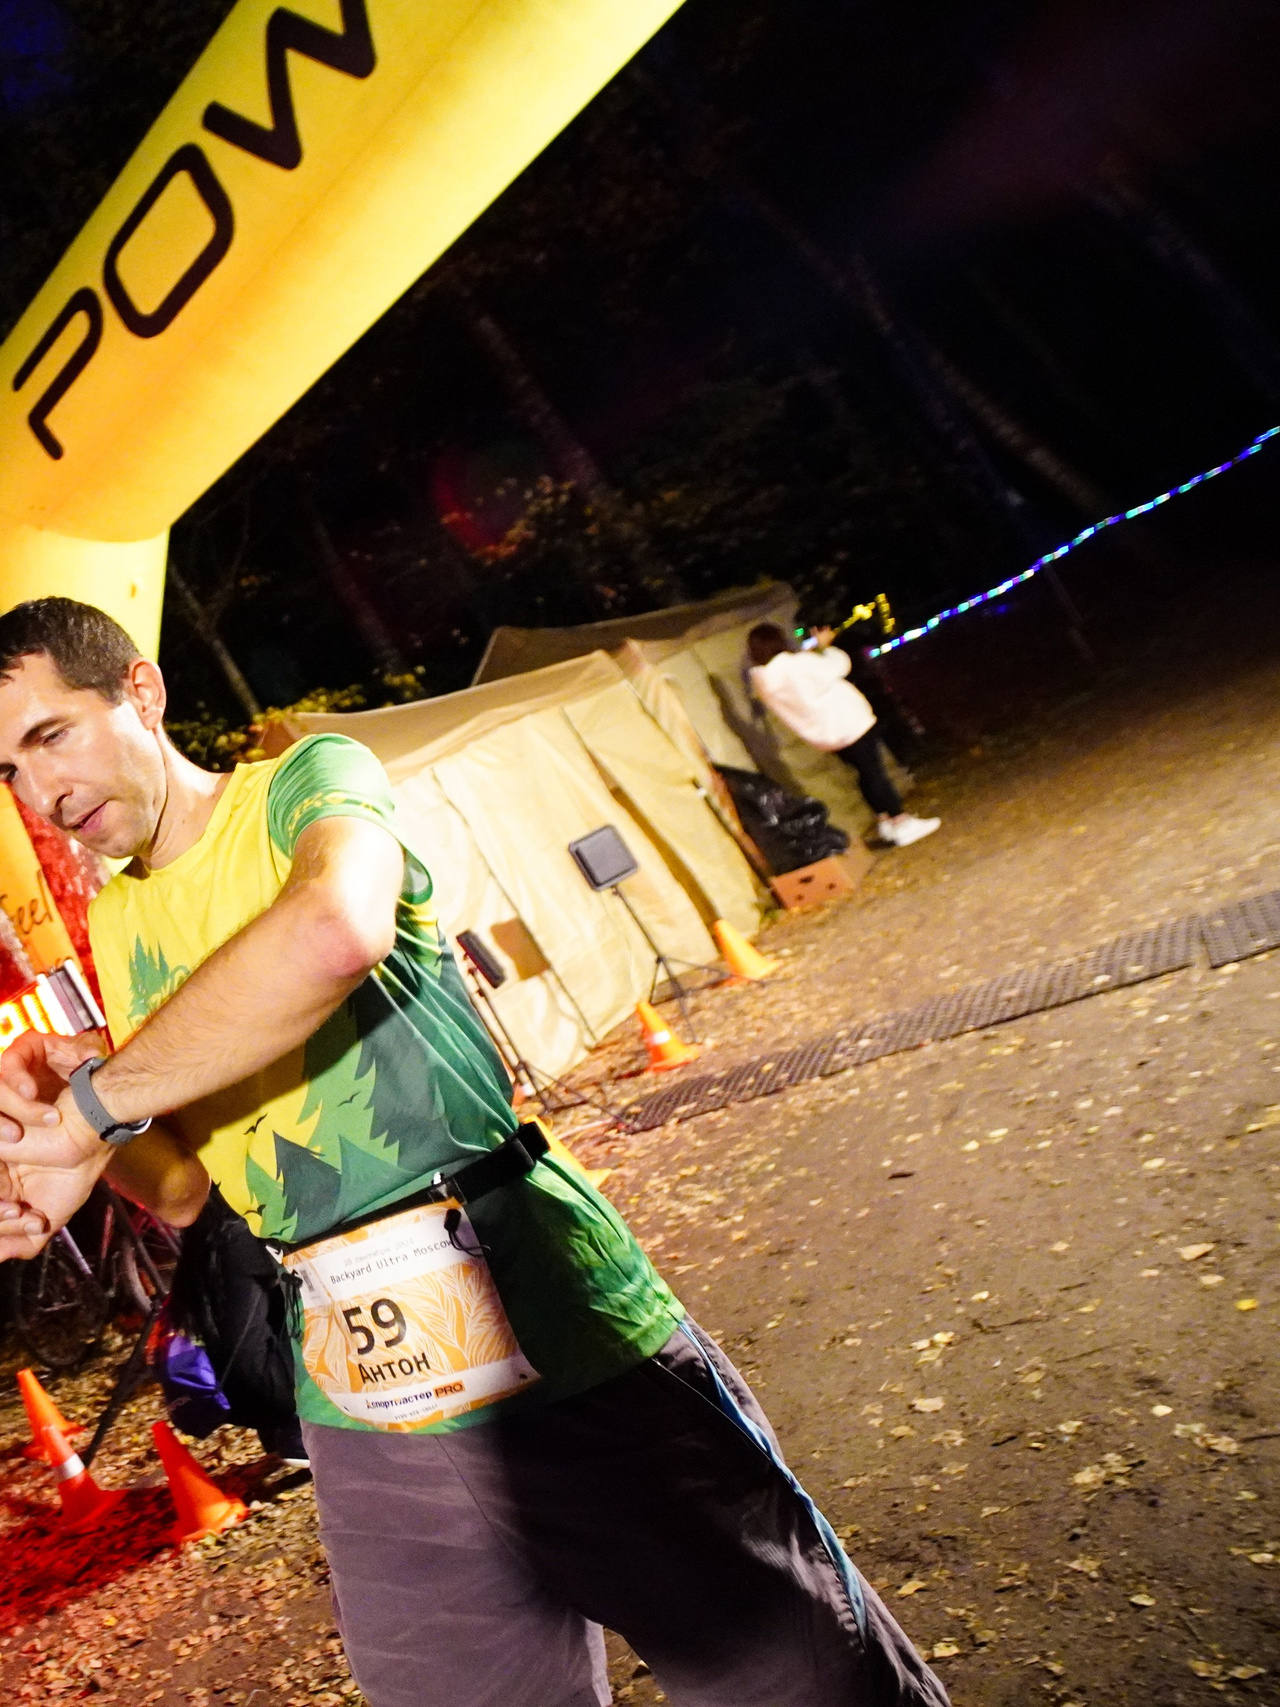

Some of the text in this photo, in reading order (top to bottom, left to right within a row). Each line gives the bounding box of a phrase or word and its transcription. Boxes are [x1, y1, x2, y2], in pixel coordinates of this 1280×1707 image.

[12, 0, 377, 461] POW
[330, 1238, 454, 1285] Backyard Ultra Moscow
[341, 1297, 408, 1356] 59
[435, 1382, 464, 1398] PRO
